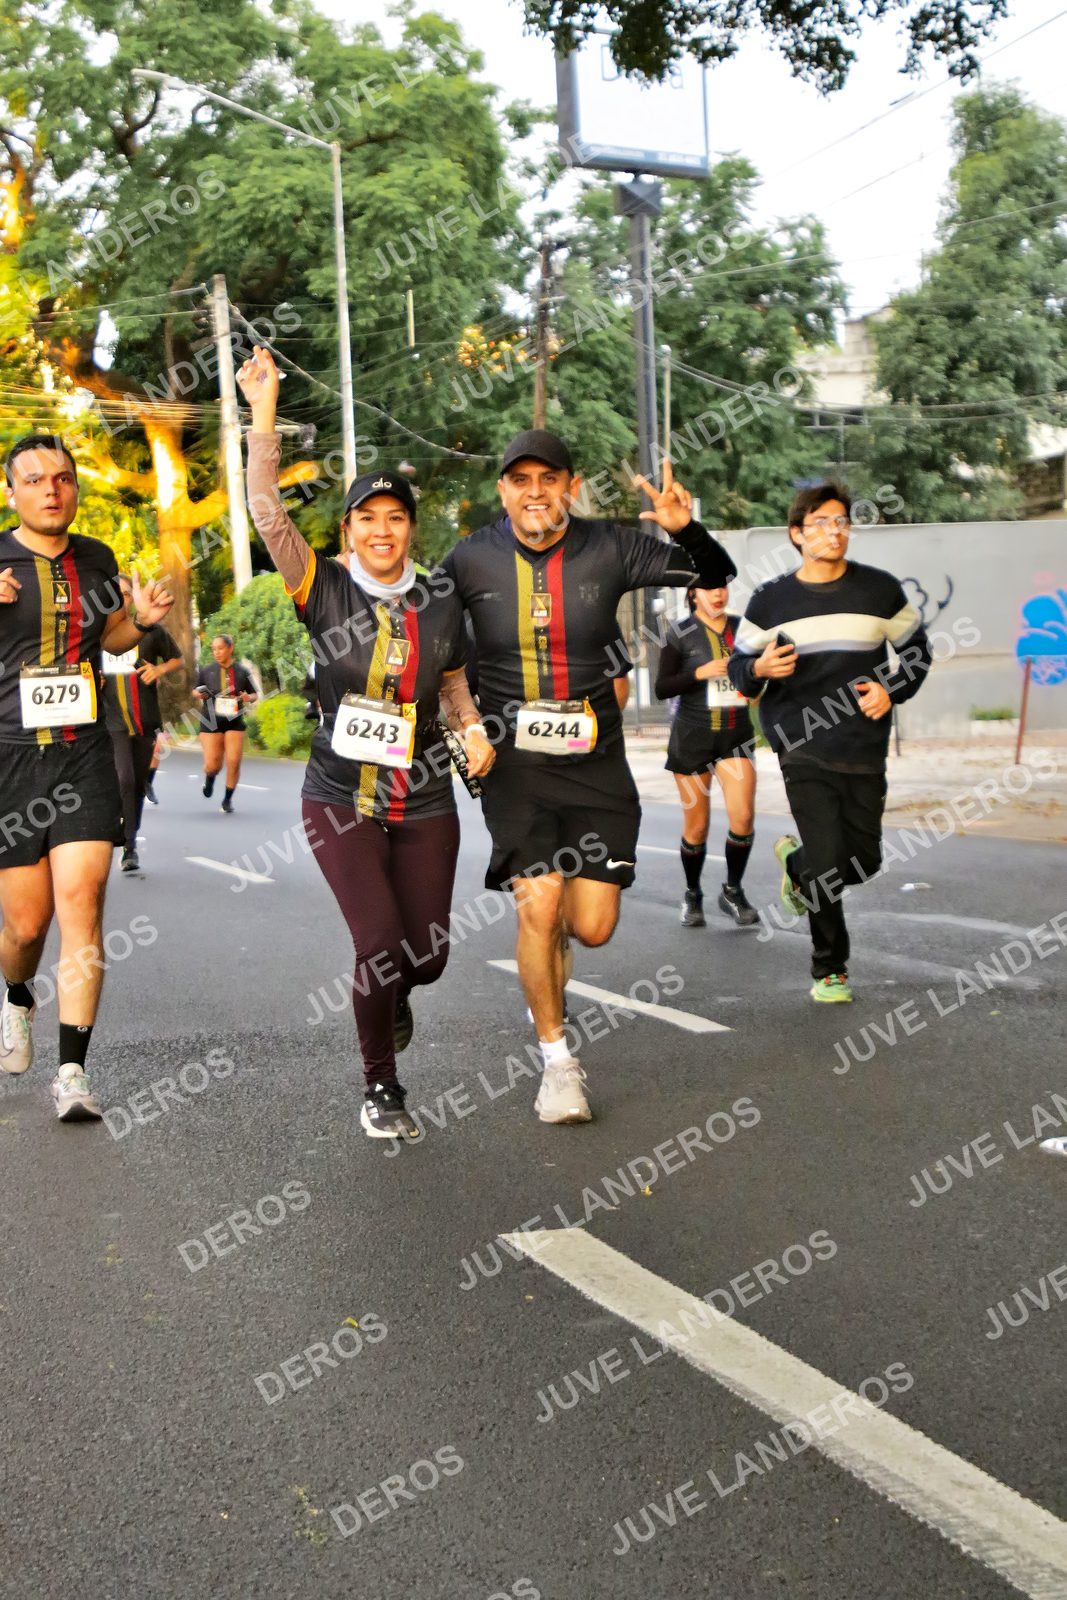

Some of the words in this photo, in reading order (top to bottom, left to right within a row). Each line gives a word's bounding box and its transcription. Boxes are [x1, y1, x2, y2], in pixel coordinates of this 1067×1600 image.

[32, 684, 80, 705] 6279
[346, 717, 400, 744] 6243
[528, 721, 580, 738] 6244
